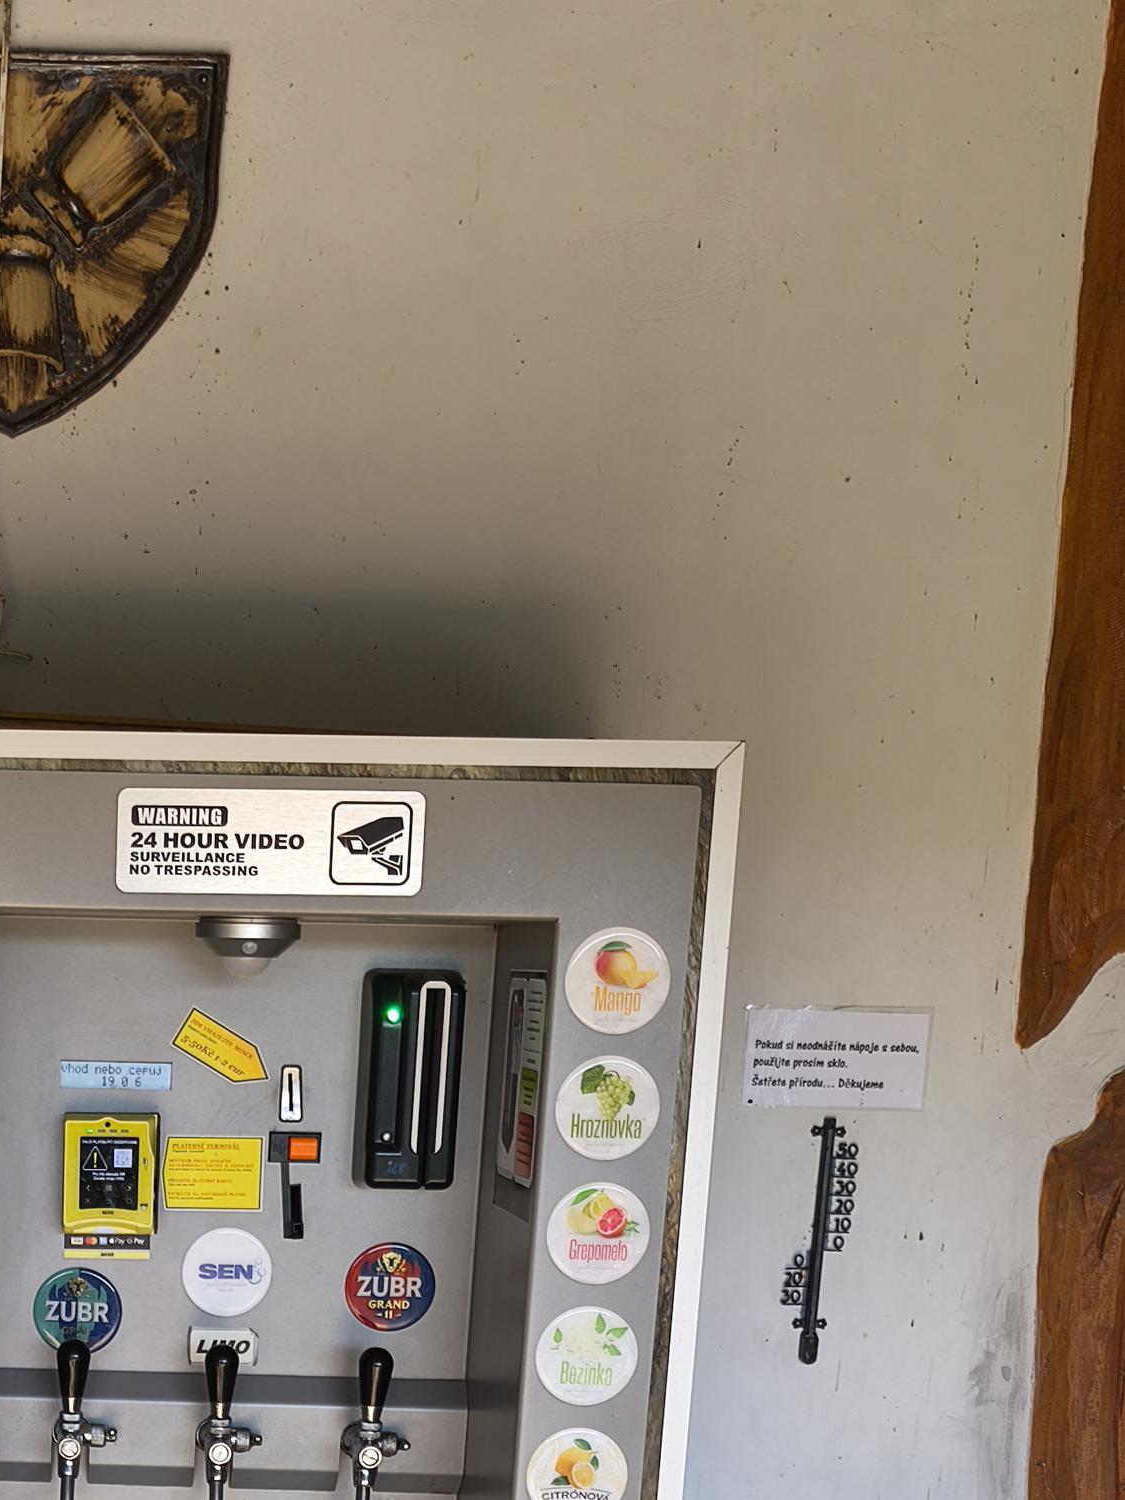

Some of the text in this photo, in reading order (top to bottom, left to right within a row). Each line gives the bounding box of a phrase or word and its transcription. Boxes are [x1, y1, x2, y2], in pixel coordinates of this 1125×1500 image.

[137, 807, 222, 825] WARNING
[131, 832, 305, 850] 24 HOUR VIDEO
[130, 851, 245, 864] SURVEILLANCE
[129, 864, 259, 877] NO TRESPASSING
[594, 986, 641, 1016] Mango
[755, 1039, 783, 1050] Pokud
[786, 1040, 794, 1050] si
[849, 1042, 879, 1054] nápoje
[890, 1044, 919, 1054] sebou,
[61, 1064, 89, 1074] vhod
[95, 1064, 122, 1074] nebo
[793, 1058, 825, 1069] prosím
[827, 1058, 849, 1068] sklo.
[102, 1076, 115, 1086] 19
[135, 1077, 141, 1087] 6
[751, 1074, 786, 1086] Šetřete
[838, 1078, 884, 1090] Děkujeme
[570, 1112, 642, 1139] Hroznovka
[836, 1143, 859, 1158] 50
[837, 1162, 859, 1176] 40
[835, 1180, 857, 1195] 30
[834, 1198, 855, 1214] 20
[833, 1217, 852, 1232] 10
[833, 1236, 845, 1250] 0
[569, 1239, 628, 1264] Grepomelo
[199, 1263, 253, 1280] SEN
[356, 1276, 422, 1298] ZUBR
[781, 1290, 801, 1304] 30
[45, 1300, 109, 1324] ZUBR
[368, 1300, 410, 1310] GRAND
[560, 1361, 613, 1386] Bezinka
